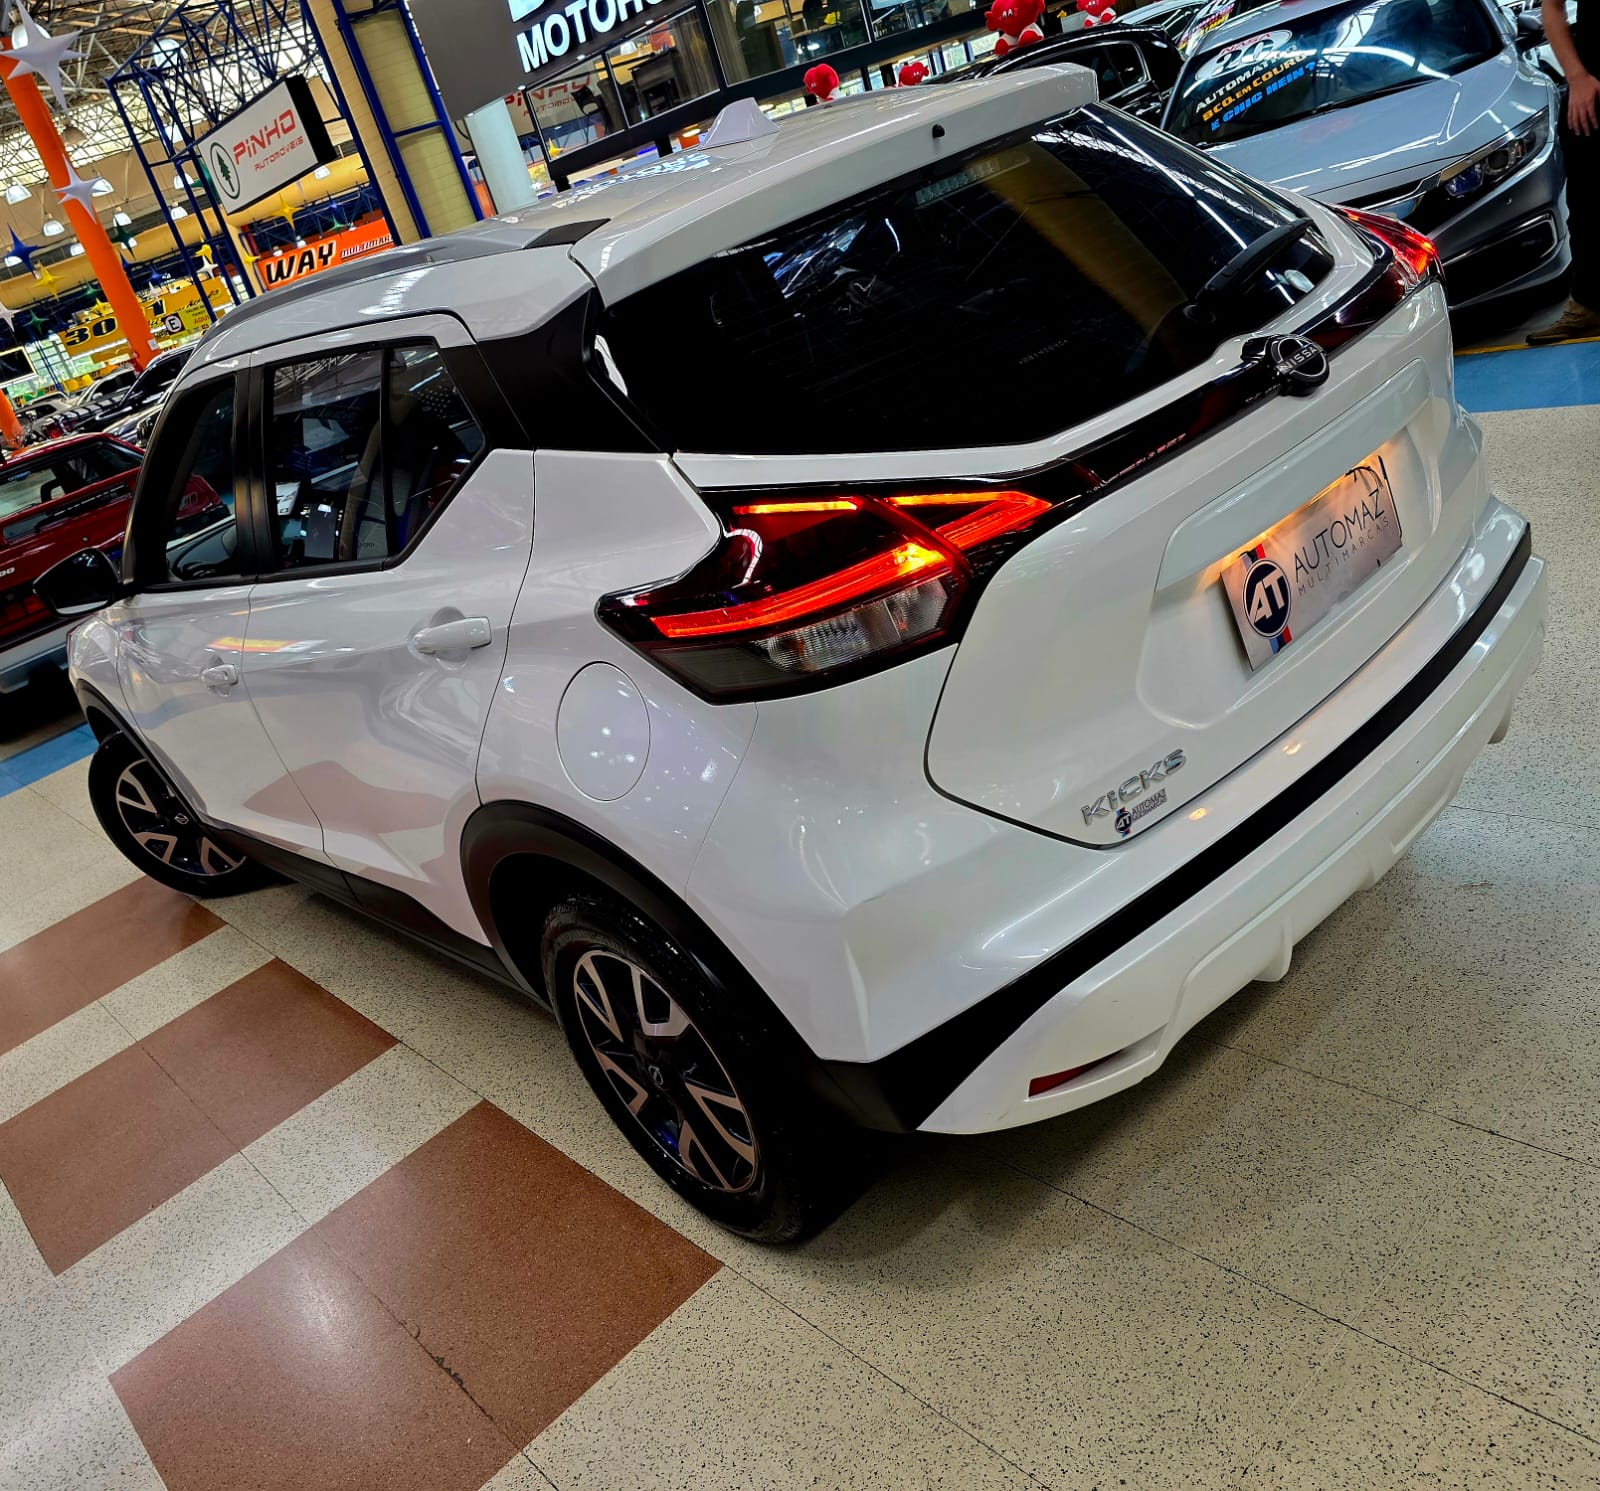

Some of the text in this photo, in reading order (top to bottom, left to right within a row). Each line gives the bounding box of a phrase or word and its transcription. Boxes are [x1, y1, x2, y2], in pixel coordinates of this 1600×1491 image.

[1222, 91, 1263, 122] CHIC
[1266, 67, 1304, 96] HEIN
[265, 240, 337, 285] WAY
[1294, 488, 1385, 583] AUTOMAZ
[1298, 516, 1390, 596] MULTIMARCAS
[1250, 568, 1286, 624] AT
[1081, 749, 1187, 827] KICKS
